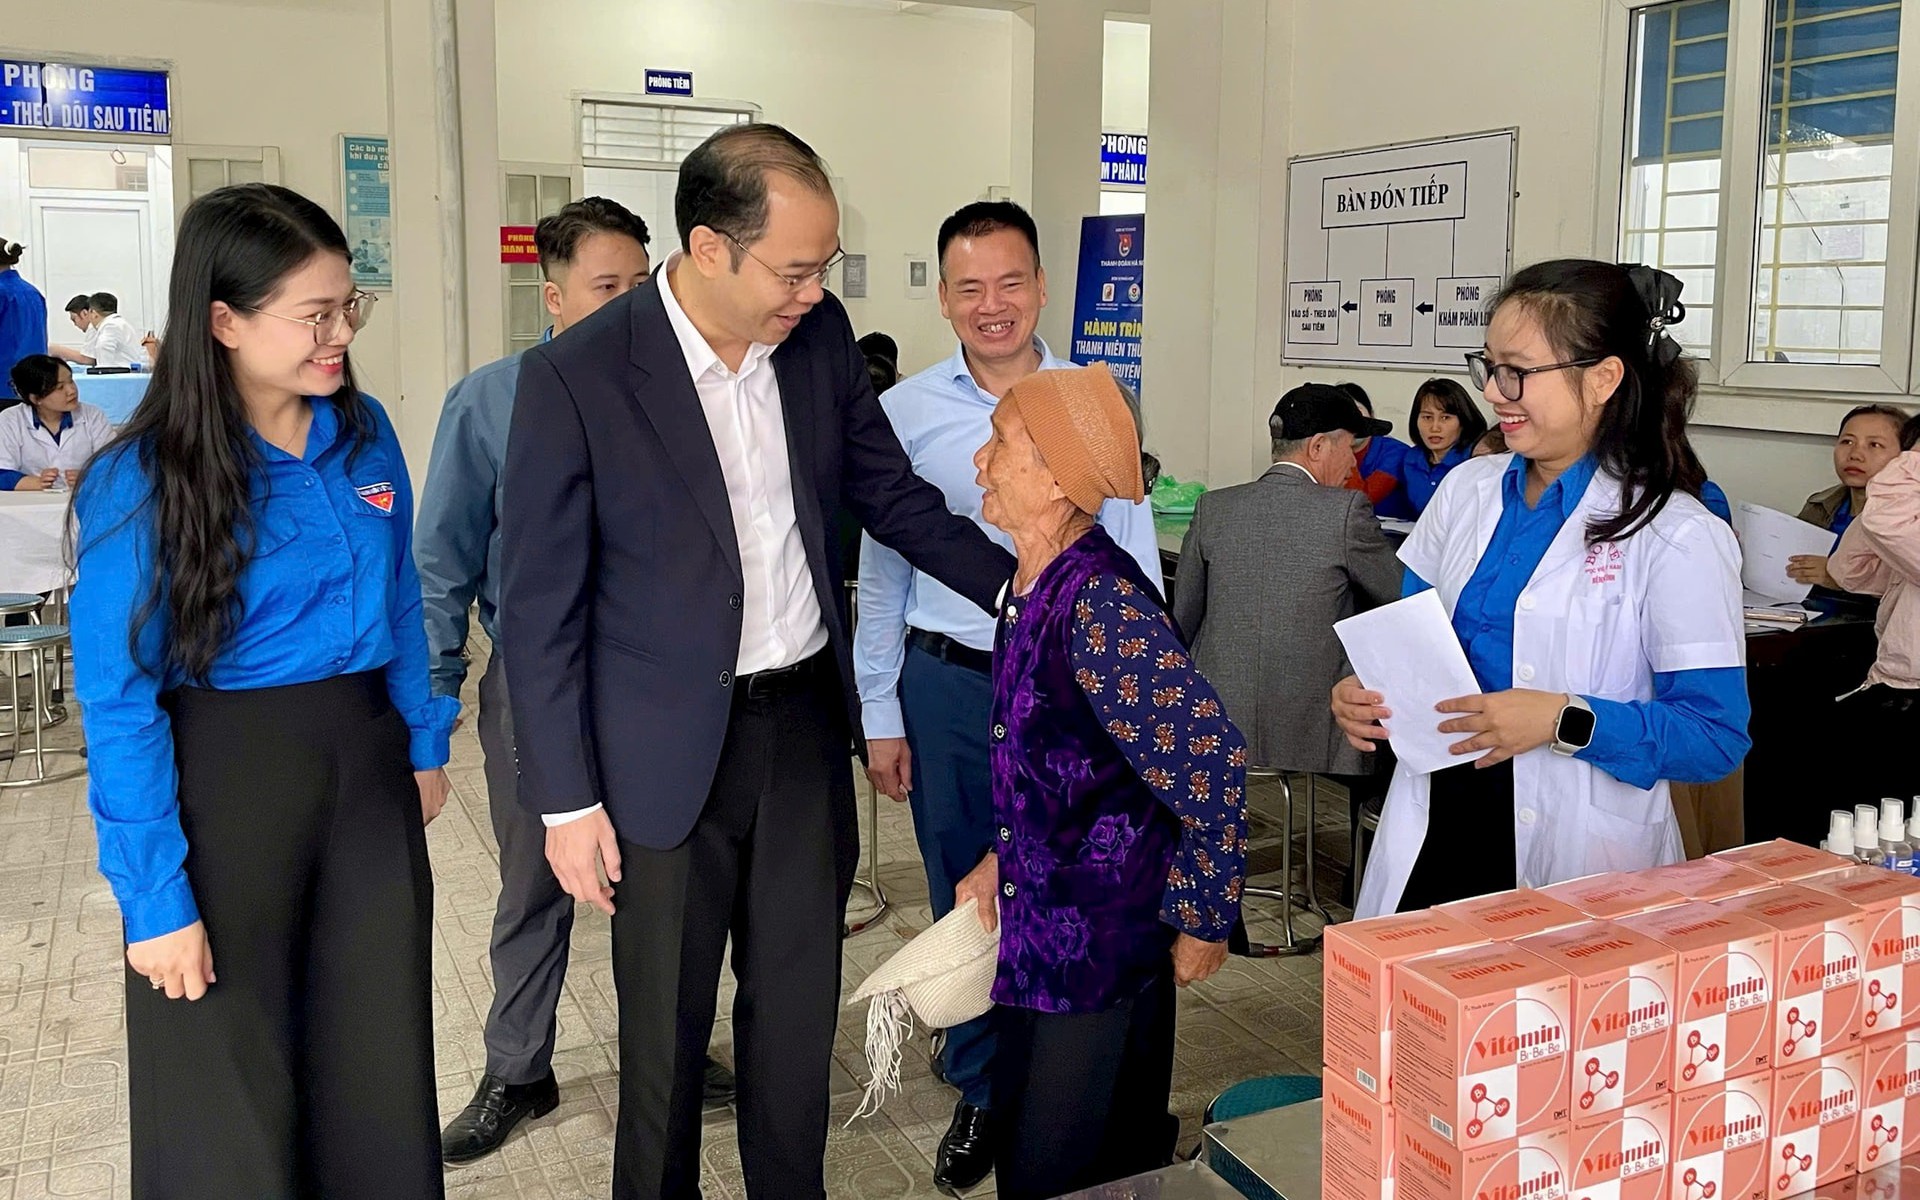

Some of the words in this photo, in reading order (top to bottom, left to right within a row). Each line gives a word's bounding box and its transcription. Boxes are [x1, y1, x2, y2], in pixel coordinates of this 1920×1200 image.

[12, 101, 54, 126] THEO
[93, 105, 125, 130] SAU
[128, 103, 168, 133] TIÊM
[1336, 187, 1366, 213] BÀN
[1370, 183, 1406, 210] ĐÓN
[1410, 173, 1449, 207] TIẾP
[1455, 282, 1480, 301] PHÒNG
[1083, 317, 1117, 337] HÀNH
[1301, 322, 1312, 331] SAU
[1438, 308, 1458, 326] KHÁM
[1459, 308, 1479, 326] PHÂN
[1075, 340, 1104, 355] THANH
[1104, 339, 1126, 357] NIÊN
[1791, 955, 1857, 985] Vitamin
[1401, 988, 1447, 1027] Vitamin
[1692, 976, 1764, 1009] Vitamin
[1591, 1000, 1666, 1035] Vitamin
[1474, 1024, 1560, 1060] Vitamin
[1787, 1089, 1854, 1122] Vitamin
[1688, 1114, 1762, 1146] Vitamin
[1404, 1134, 1452, 1174] Vitamin
[1583, 1140, 1661, 1175] Vitamin
